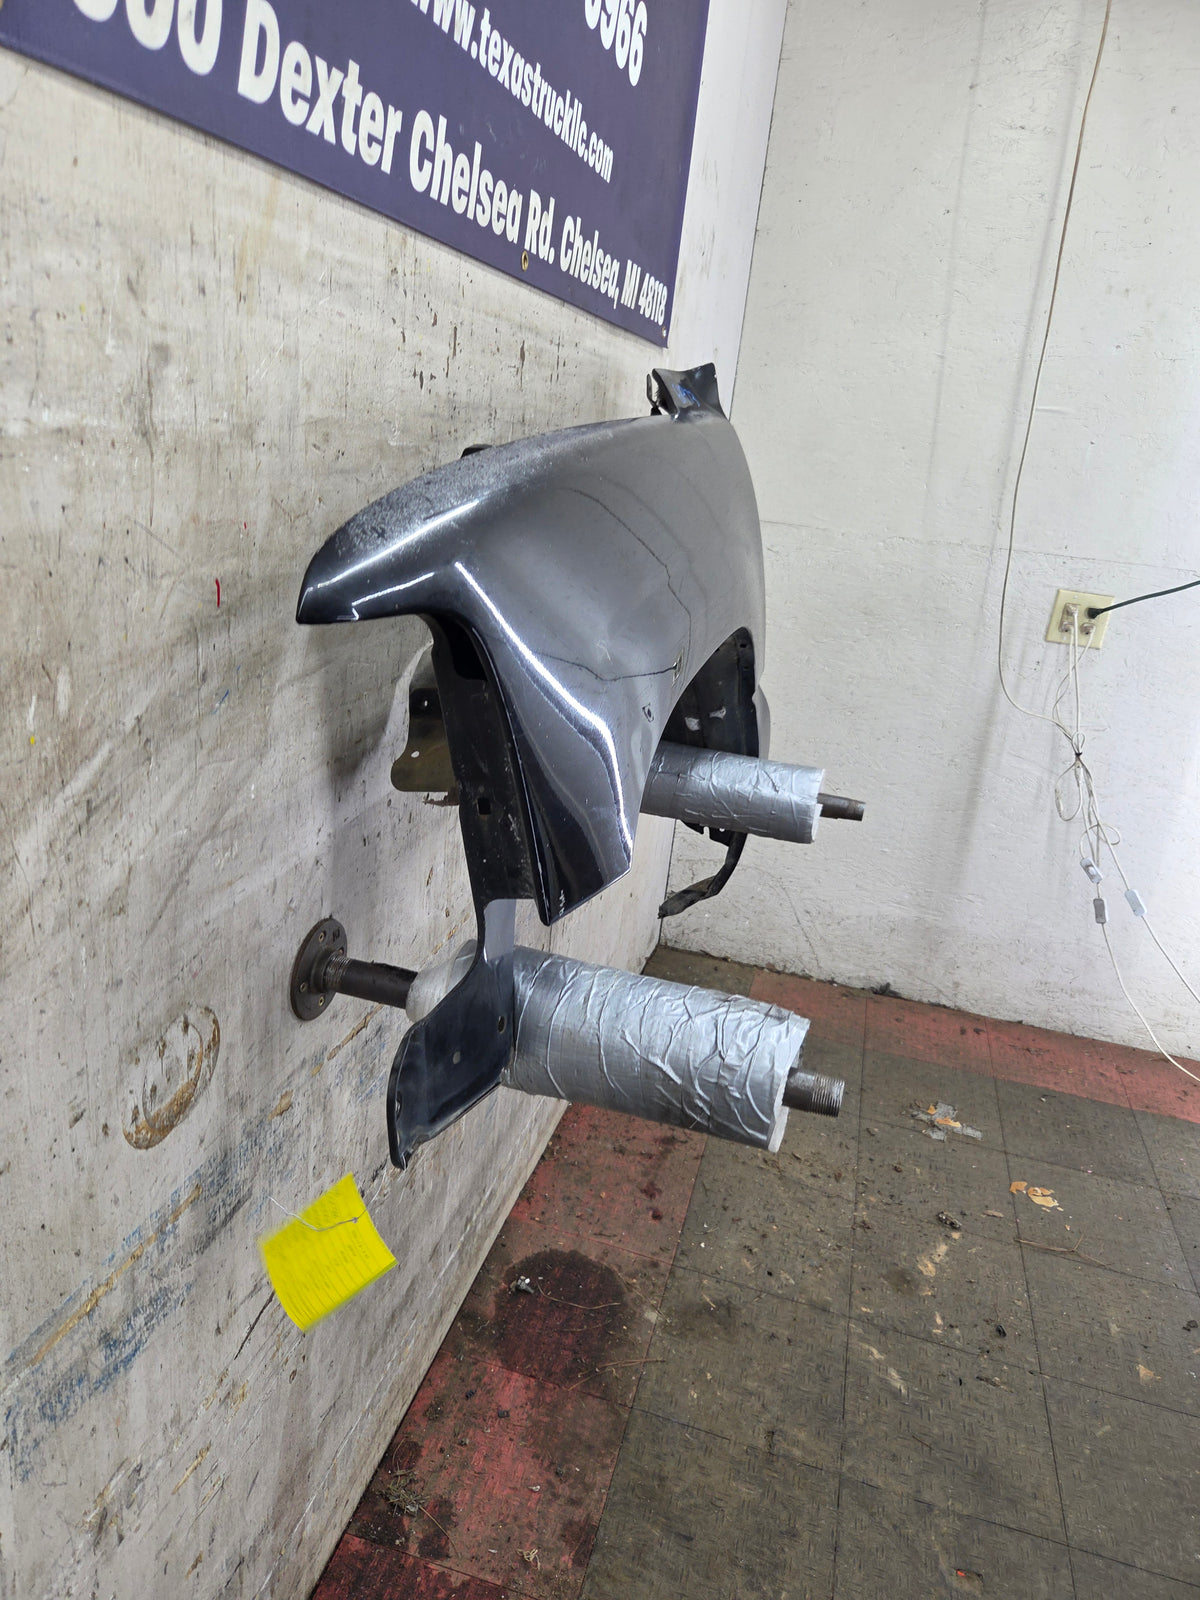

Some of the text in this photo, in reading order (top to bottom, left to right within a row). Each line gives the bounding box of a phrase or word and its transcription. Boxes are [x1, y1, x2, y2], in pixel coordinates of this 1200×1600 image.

[238, 0, 402, 174] Dexter
[410, 110, 523, 243] Chelsea
[524, 189, 555, 264] Rd.
[560, 215, 621, 310] Chelsea,
[620, 258, 642, 310] MI
[637, 272, 668, 326] 48118
[410, 0, 614, 184] ww.texastruckllc.com
